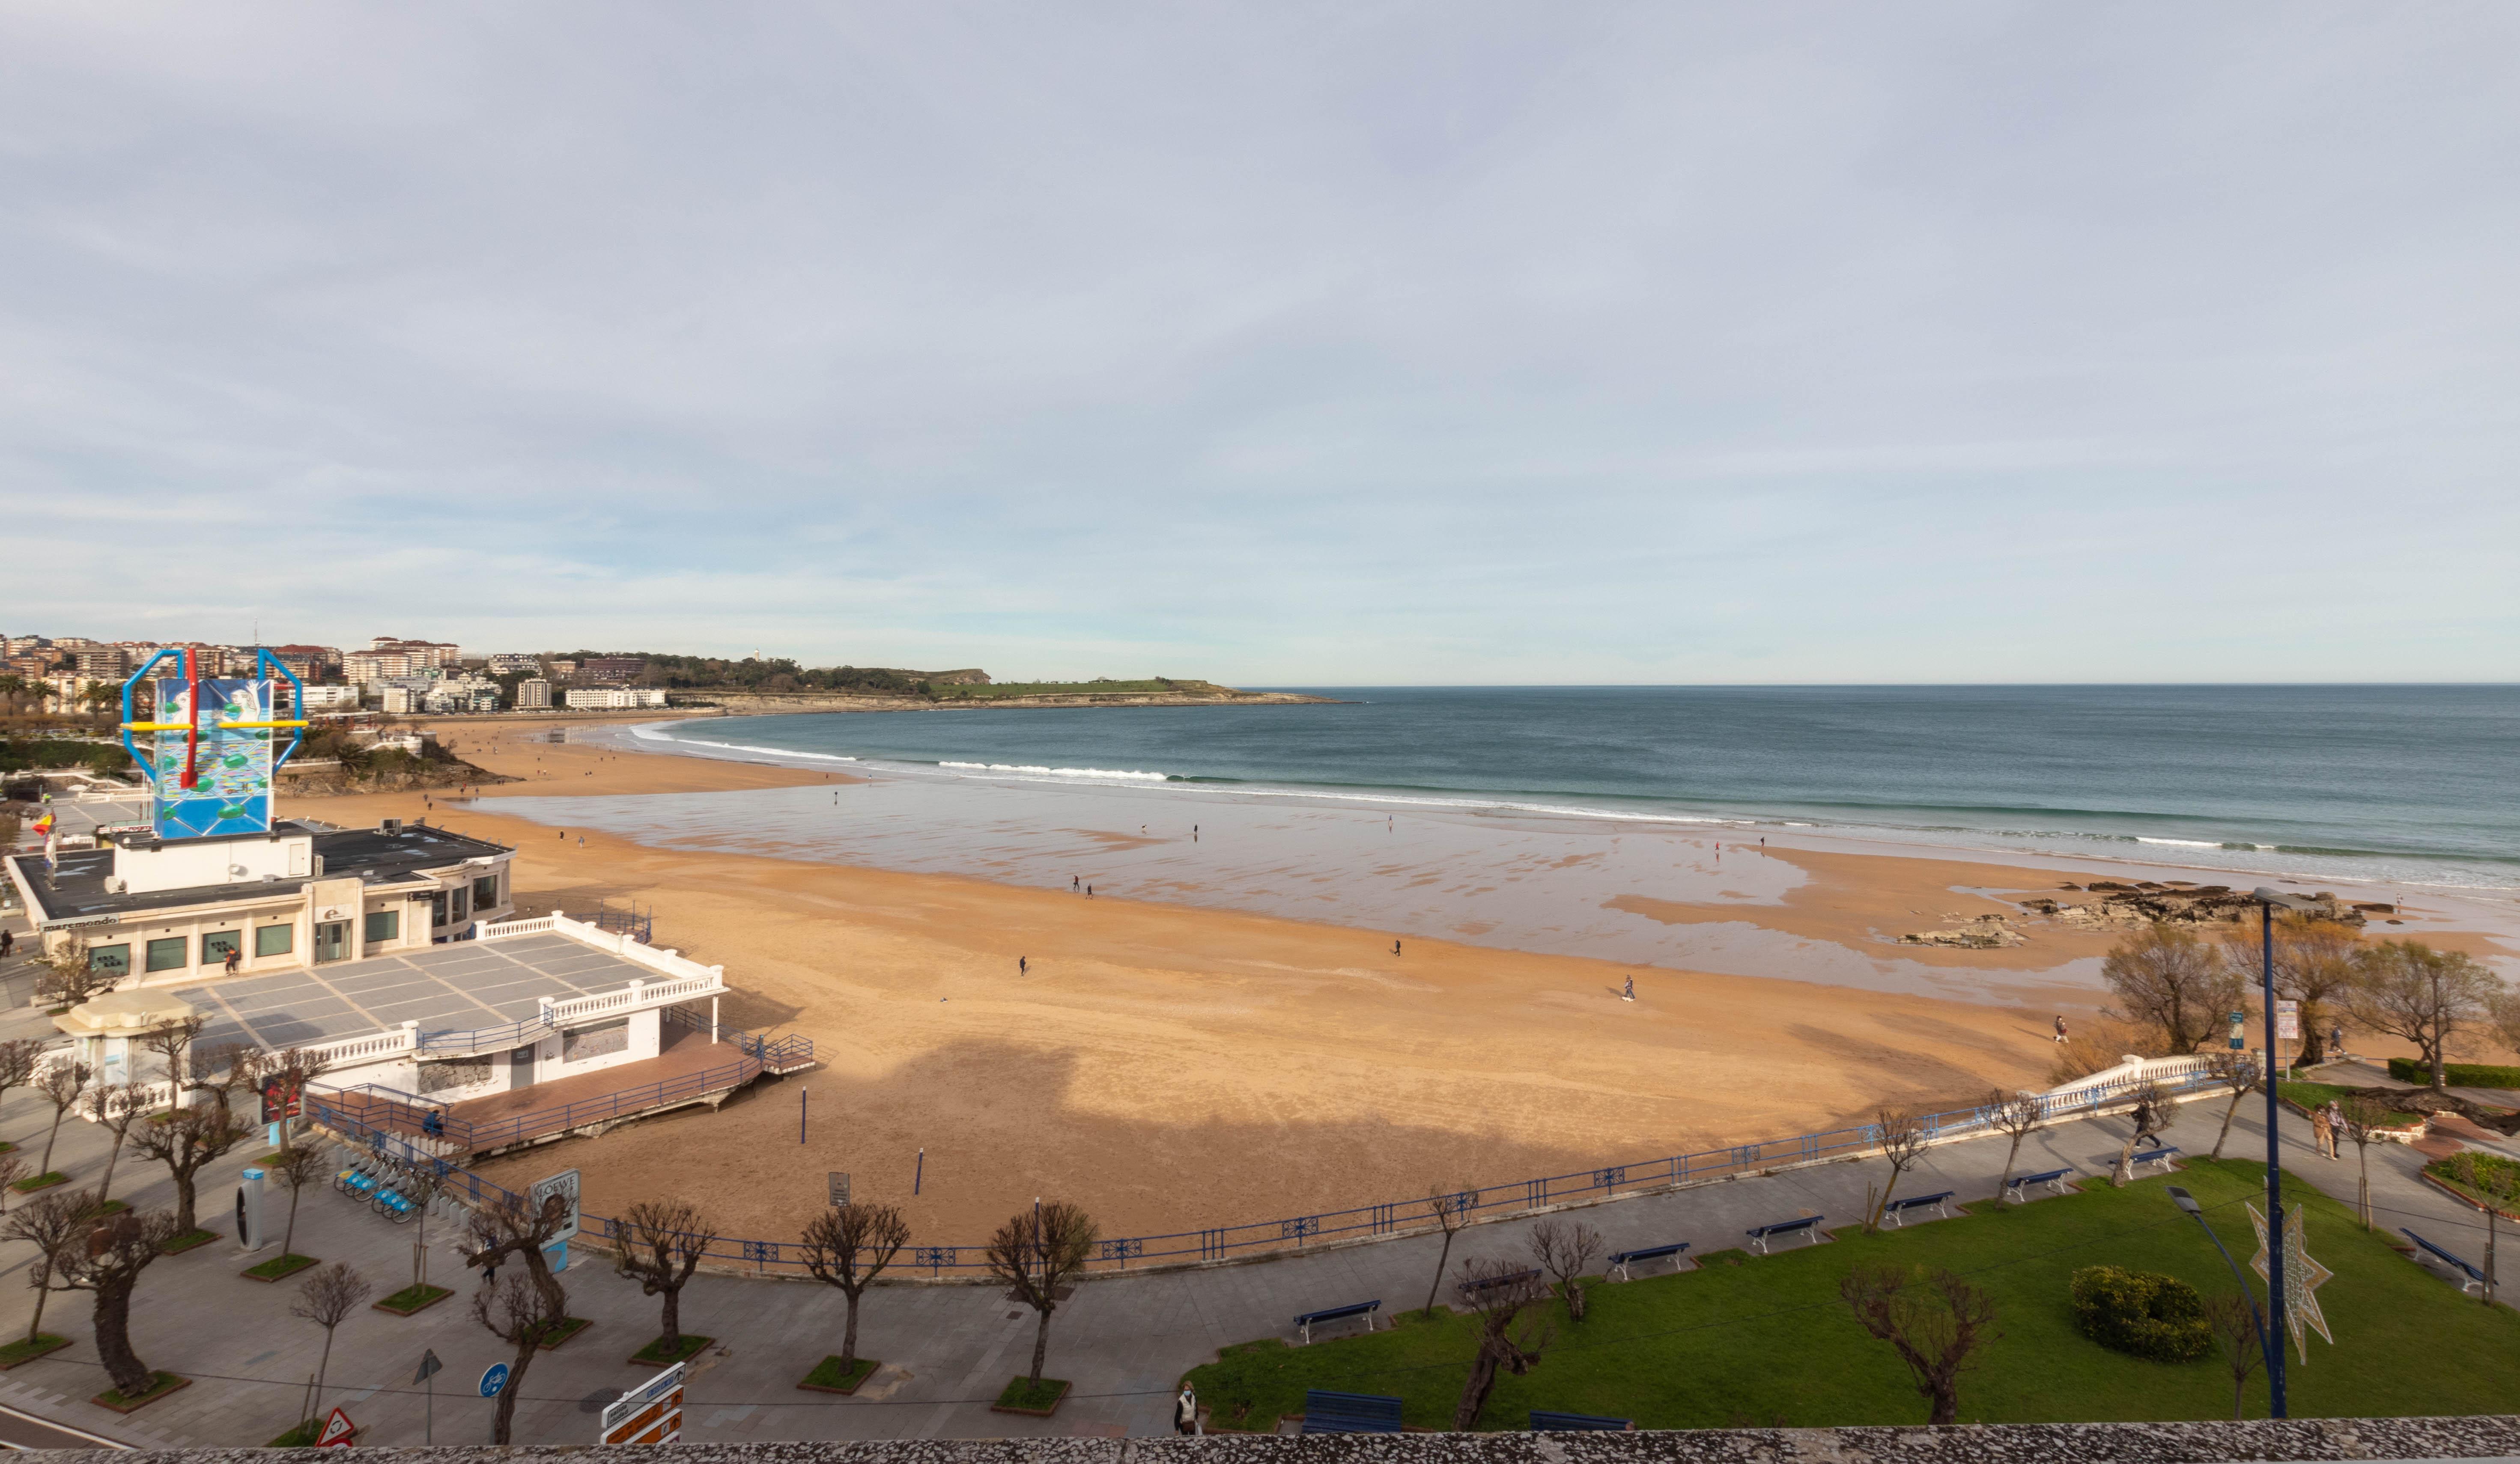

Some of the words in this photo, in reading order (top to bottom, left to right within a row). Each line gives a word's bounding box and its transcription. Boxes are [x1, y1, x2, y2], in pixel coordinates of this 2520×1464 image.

[43, 916, 117, 931] maremondo
[538, 1175, 575, 1197] LOEWE
[609, 1404, 627, 1418] salida
[609, 1408, 629, 1425] ciudad
